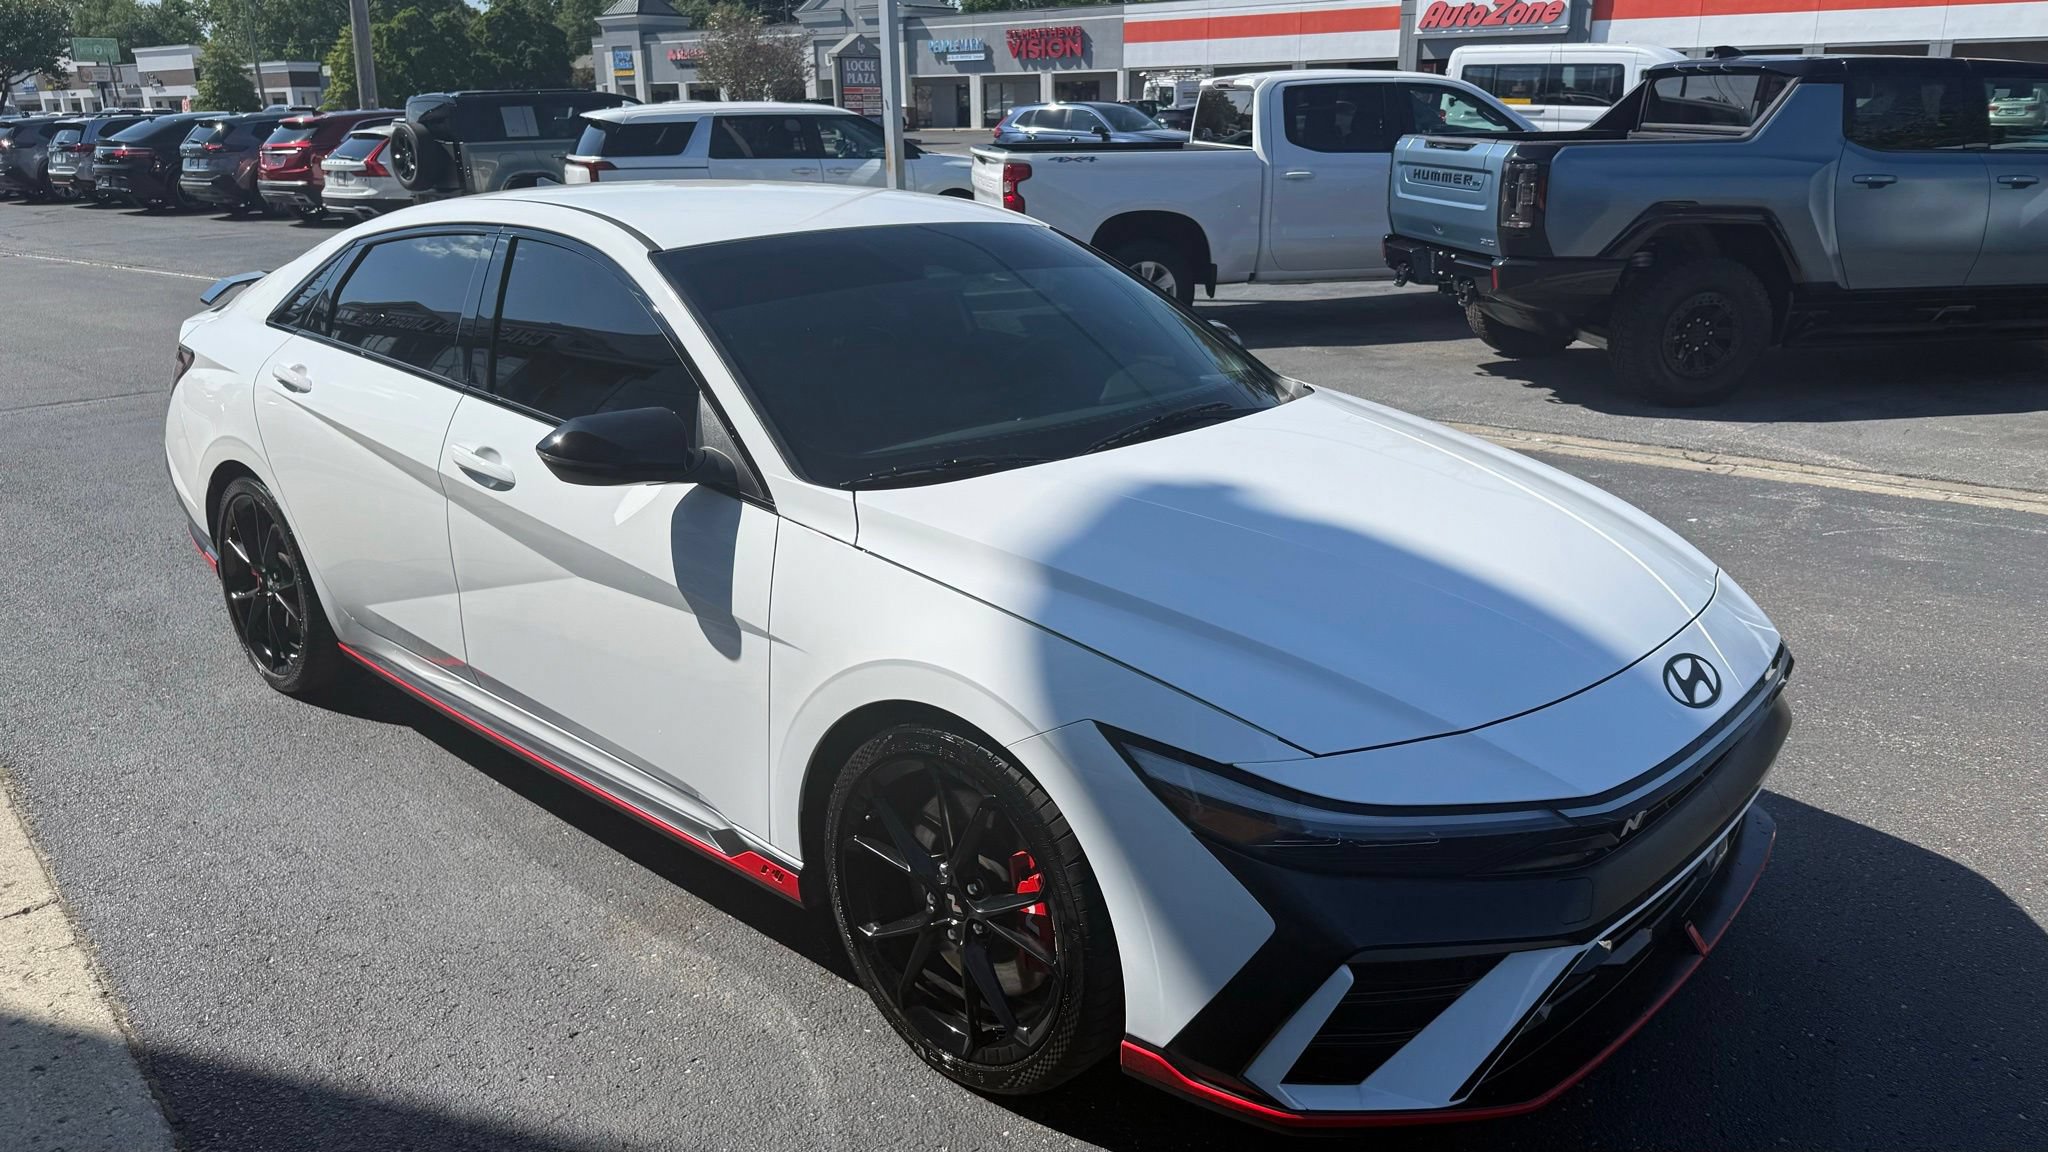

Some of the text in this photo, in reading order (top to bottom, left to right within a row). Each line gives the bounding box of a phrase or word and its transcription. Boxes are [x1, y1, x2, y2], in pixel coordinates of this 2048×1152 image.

[1418, 0, 1567, 29] AutoZone
[1020, 25, 1083, 39] MATTHEWS
[1007, 37, 1083, 59] VISION
[846, 60, 876, 72] LOCKE
[847, 73, 877, 84] PLAZA
[1413, 168, 1473, 186] HUMMER
